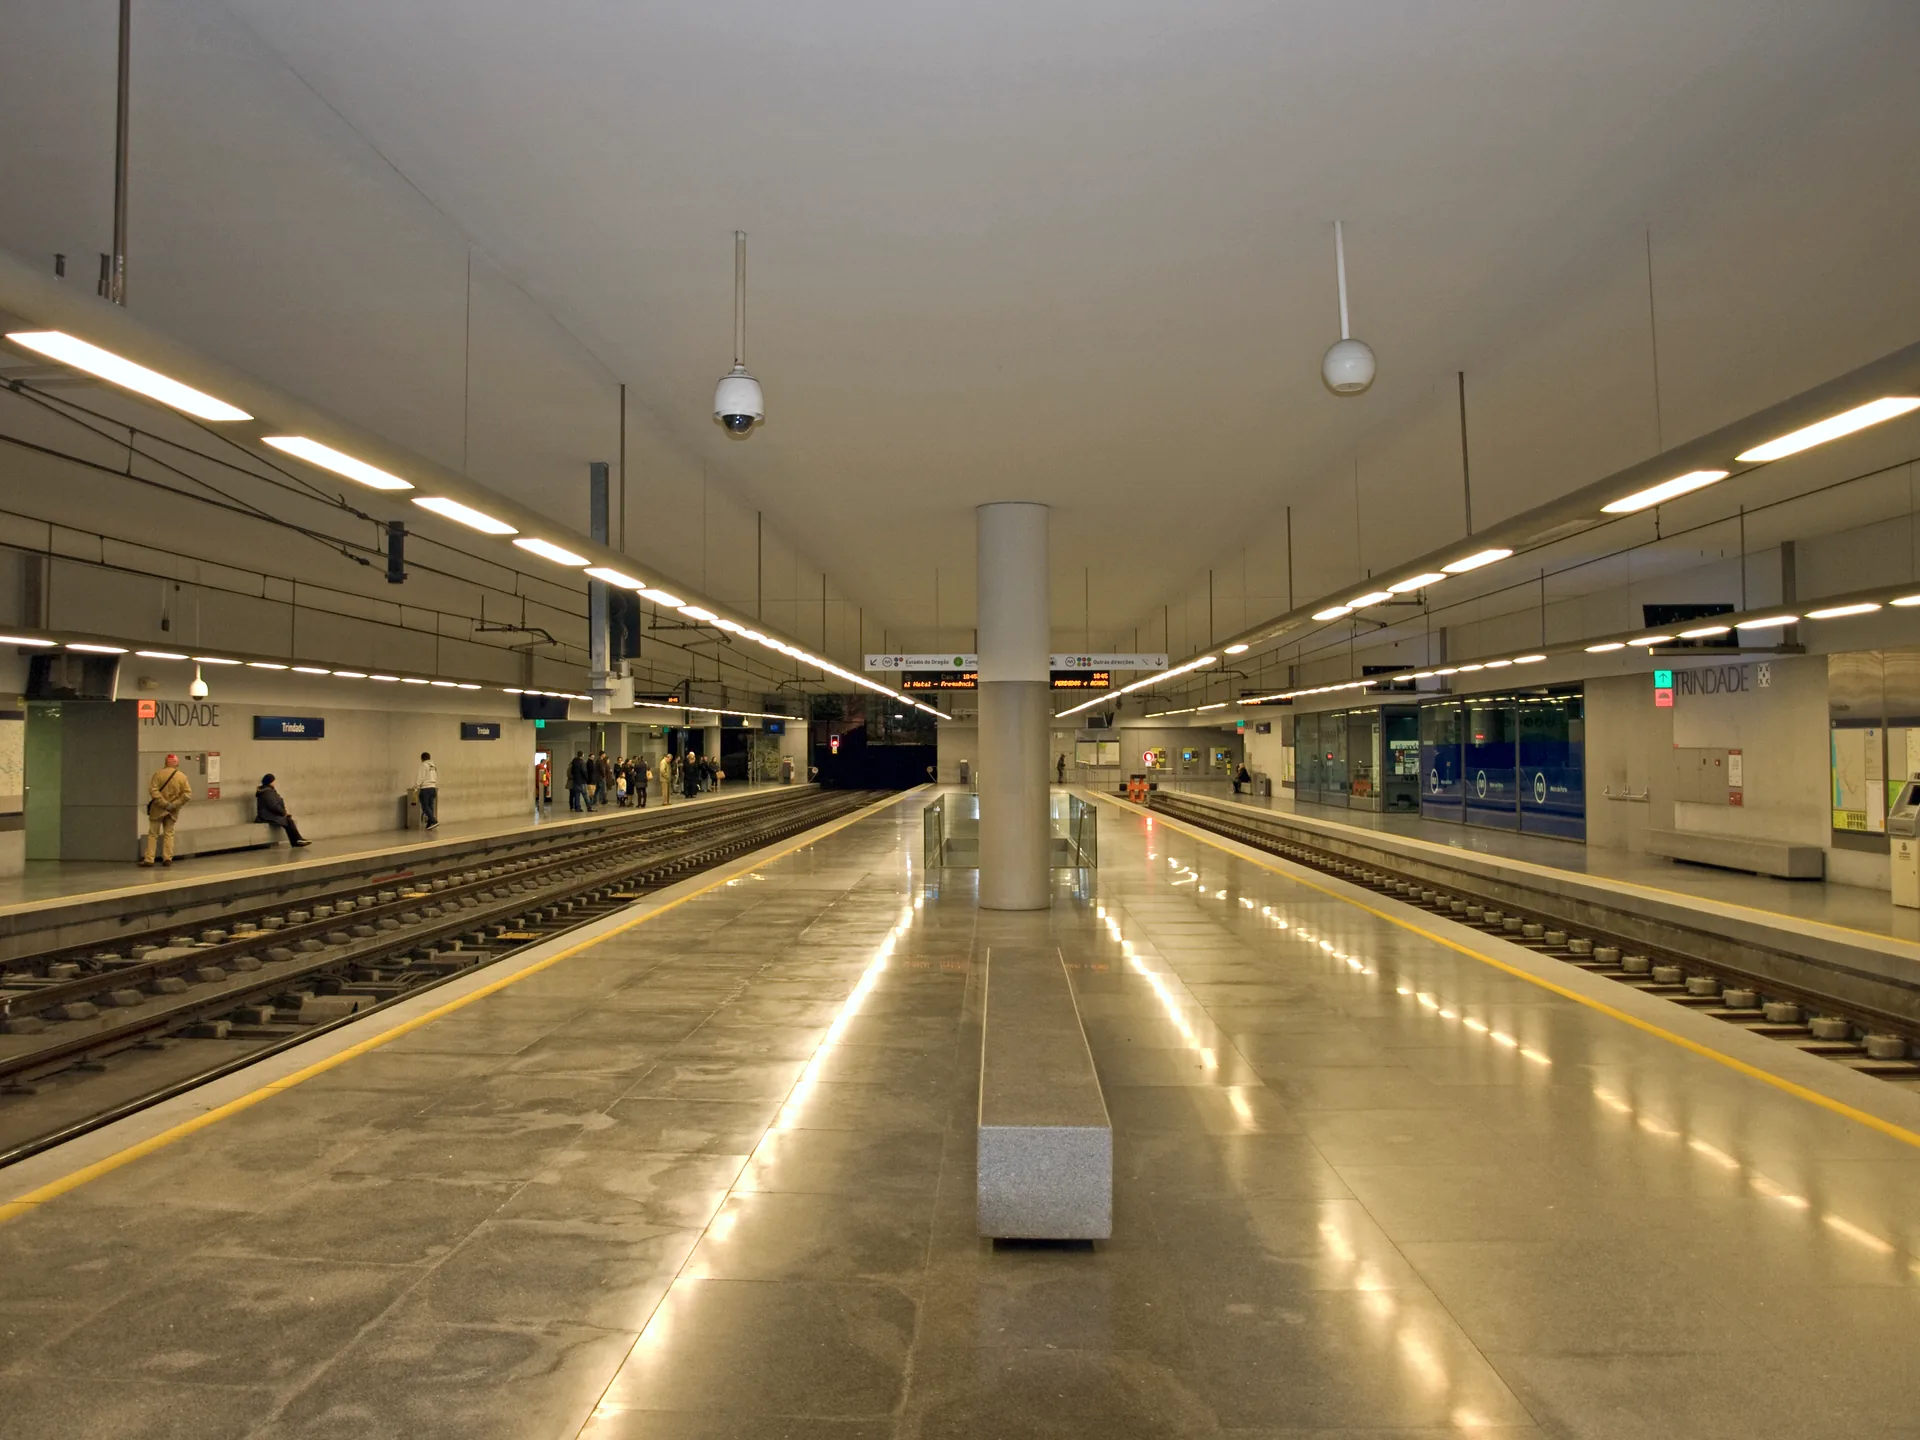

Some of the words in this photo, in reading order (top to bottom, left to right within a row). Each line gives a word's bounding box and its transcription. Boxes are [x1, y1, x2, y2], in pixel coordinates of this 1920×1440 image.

[1674, 665, 1749, 696] TRINDADE
[143, 702, 220, 727] RINDADE
[281, 722, 305, 733] Trindade
